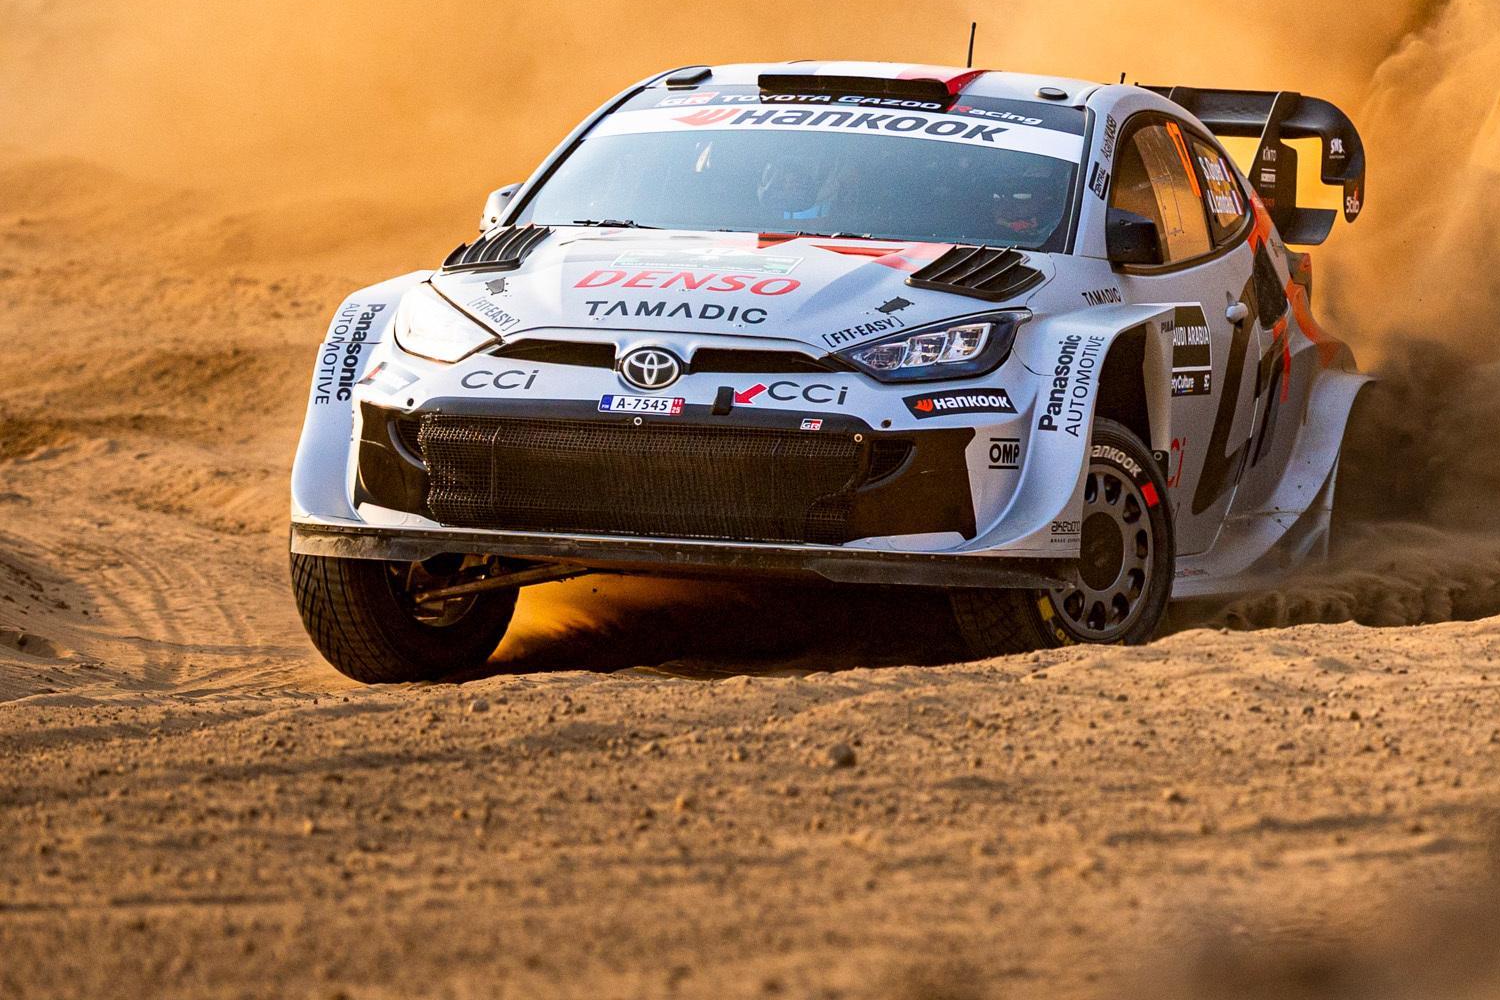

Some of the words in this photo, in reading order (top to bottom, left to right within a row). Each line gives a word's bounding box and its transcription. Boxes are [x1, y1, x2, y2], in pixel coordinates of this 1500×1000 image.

[720, 94, 832, 103] TOYOTA
[838, 95, 942, 110] GAZOO
[947, 104, 1043, 126] Racing
[573, 270, 801, 295] DENSO
[1082, 287, 1121, 306] TAMADIC
[585, 301, 768, 324] TAMADIC
[1173, 326, 1187, 346] AUDI
[314, 303, 360, 405] AUTOMOTIVE
[336, 303, 386, 402] Panasonic
[1038, 334, 1082, 432] Panasonic
[1065, 335, 1105, 437] AUTOMOTIVE
[616, 398, 668, 411] A-7545
[671, 406, 681, 414] 25
[989, 443, 1020, 464] OMP
